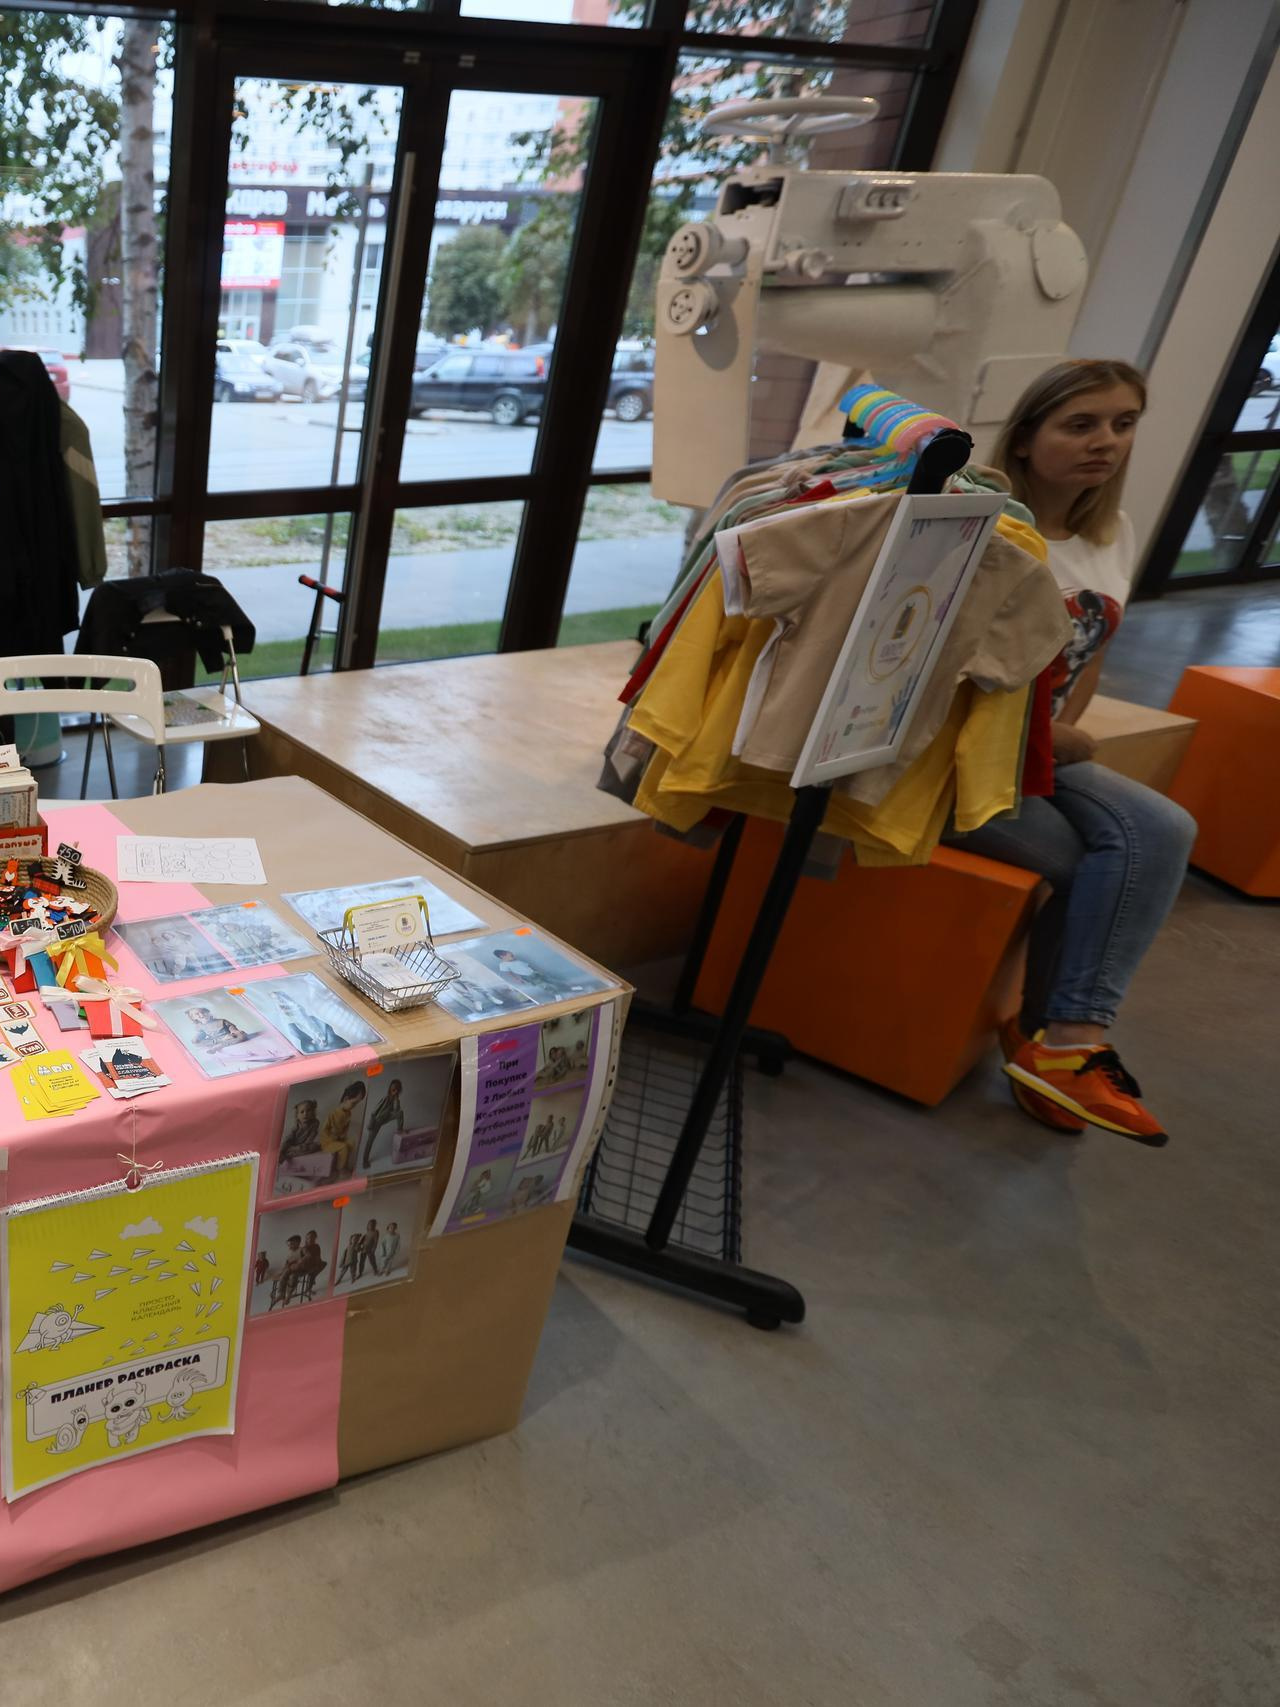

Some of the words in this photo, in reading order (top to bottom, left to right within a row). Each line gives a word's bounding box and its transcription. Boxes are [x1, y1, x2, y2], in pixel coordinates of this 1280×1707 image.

[58, 845, 80, 862] 750
[499, 1059, 519, 1070] При
[485, 1072, 527, 1088] Покупке
[483, 1096, 489, 1104] 2
[50, 1377, 114, 1404] ПЛАНЕР
[117, 1353, 201, 1385] РАСКРАСКА
